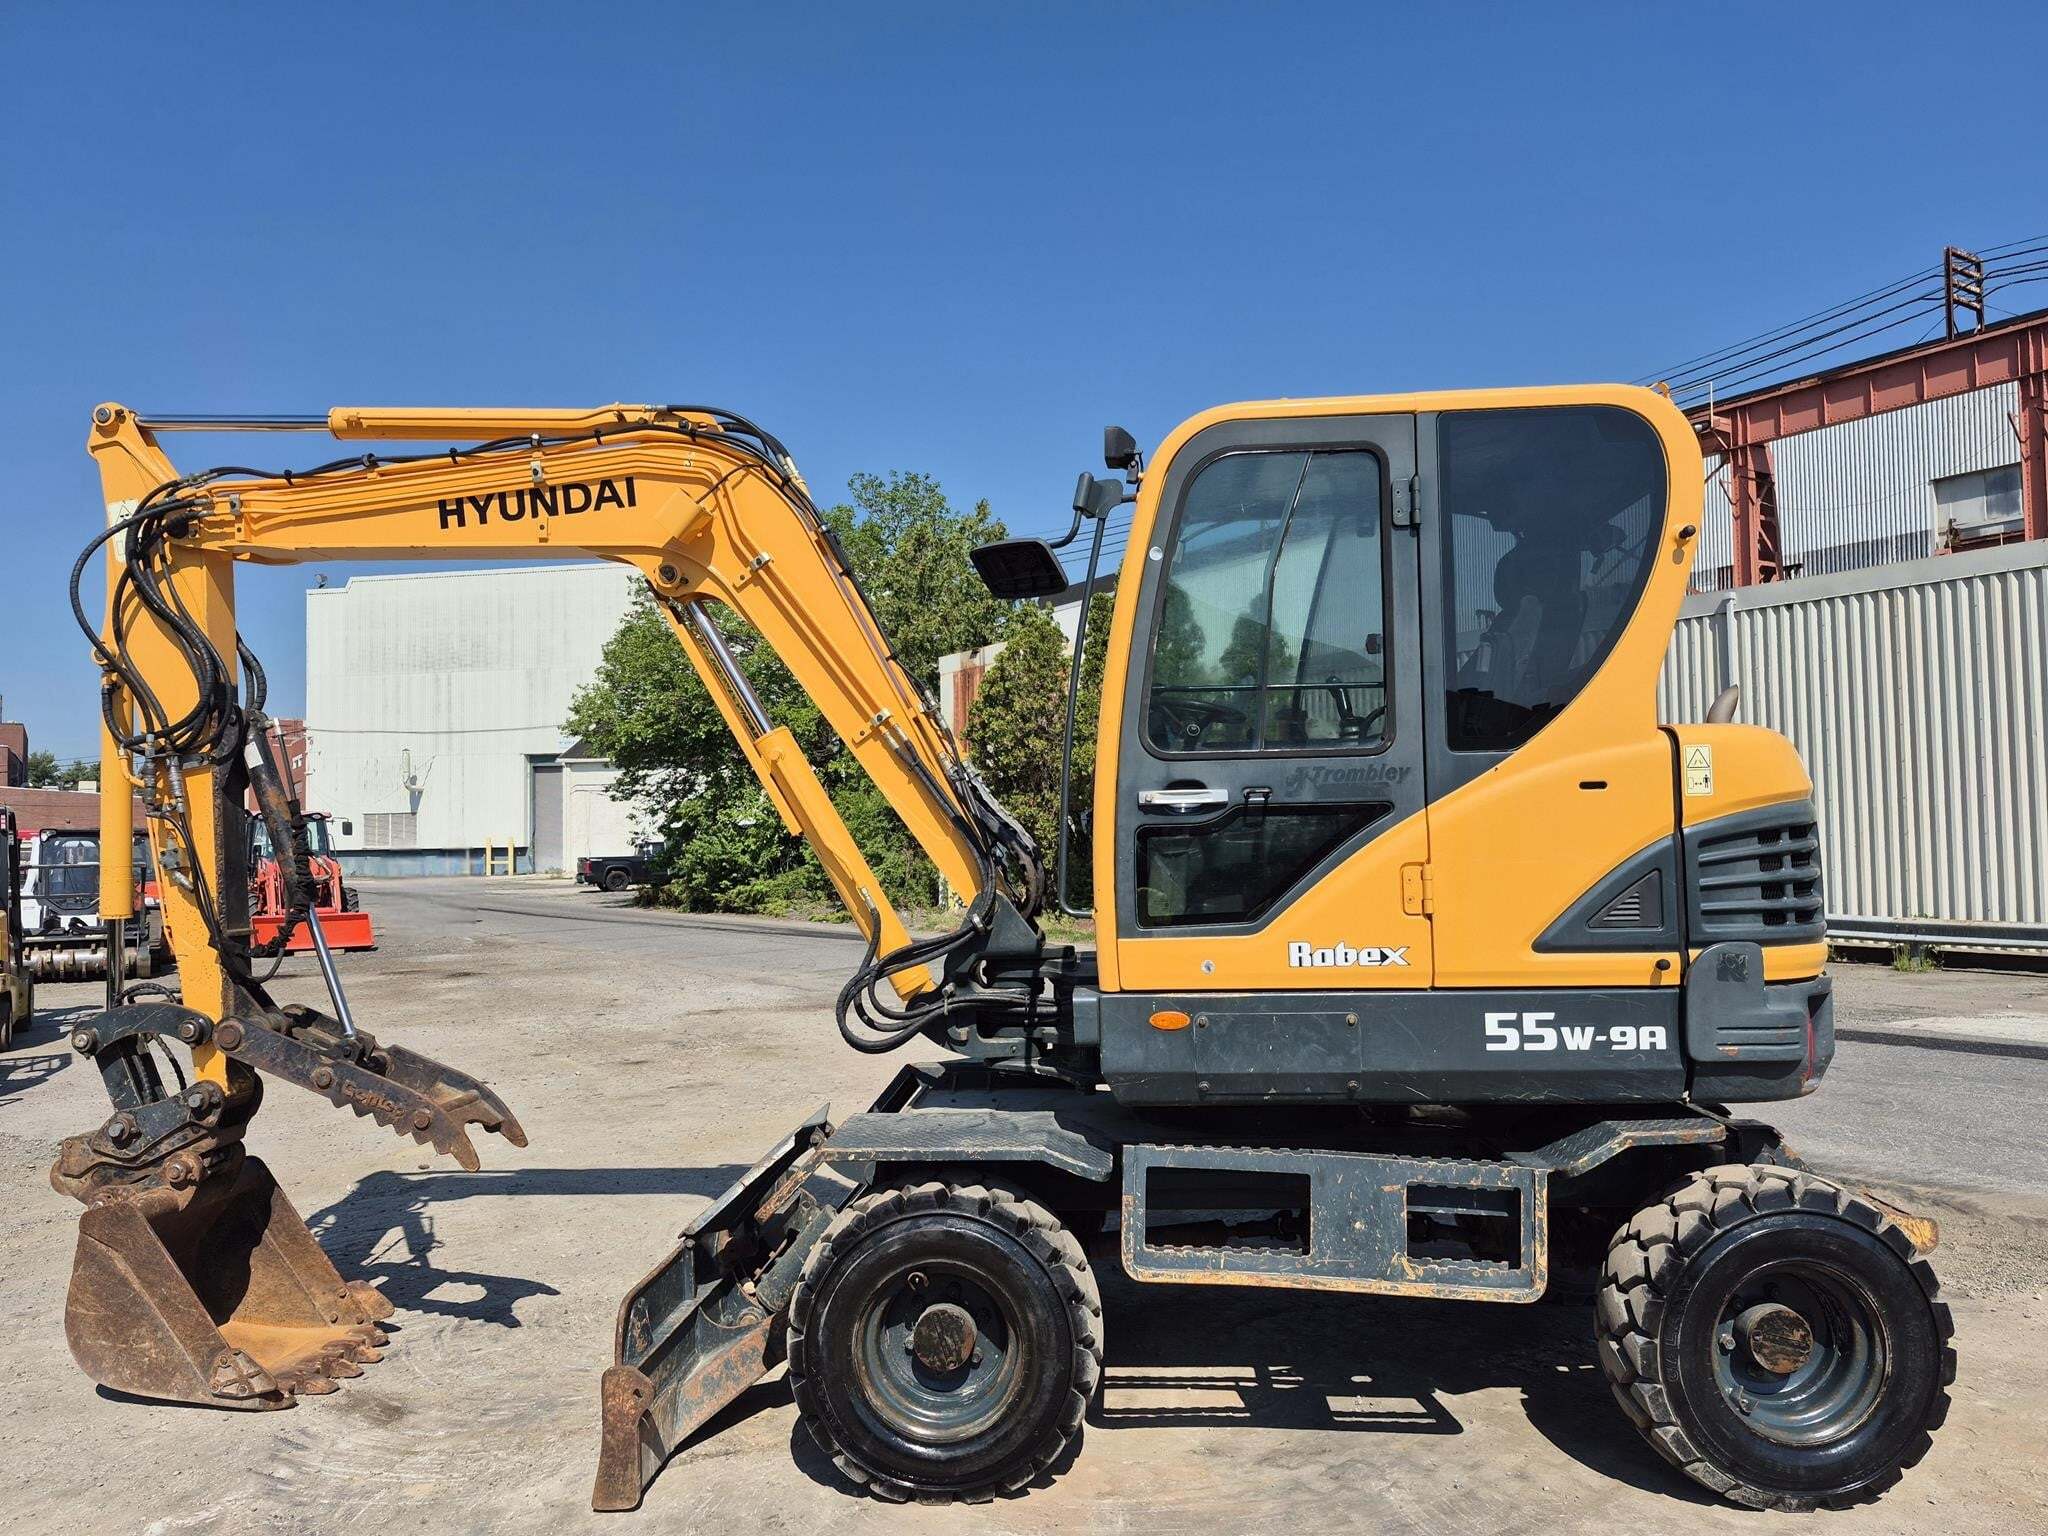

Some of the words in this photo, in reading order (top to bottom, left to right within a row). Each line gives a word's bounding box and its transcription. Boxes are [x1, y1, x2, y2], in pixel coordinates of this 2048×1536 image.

[437, 475, 637, 530] HYUNDAI
[1312, 763, 1412, 784] Trombley
[1287, 940, 1411, 968] Robex
